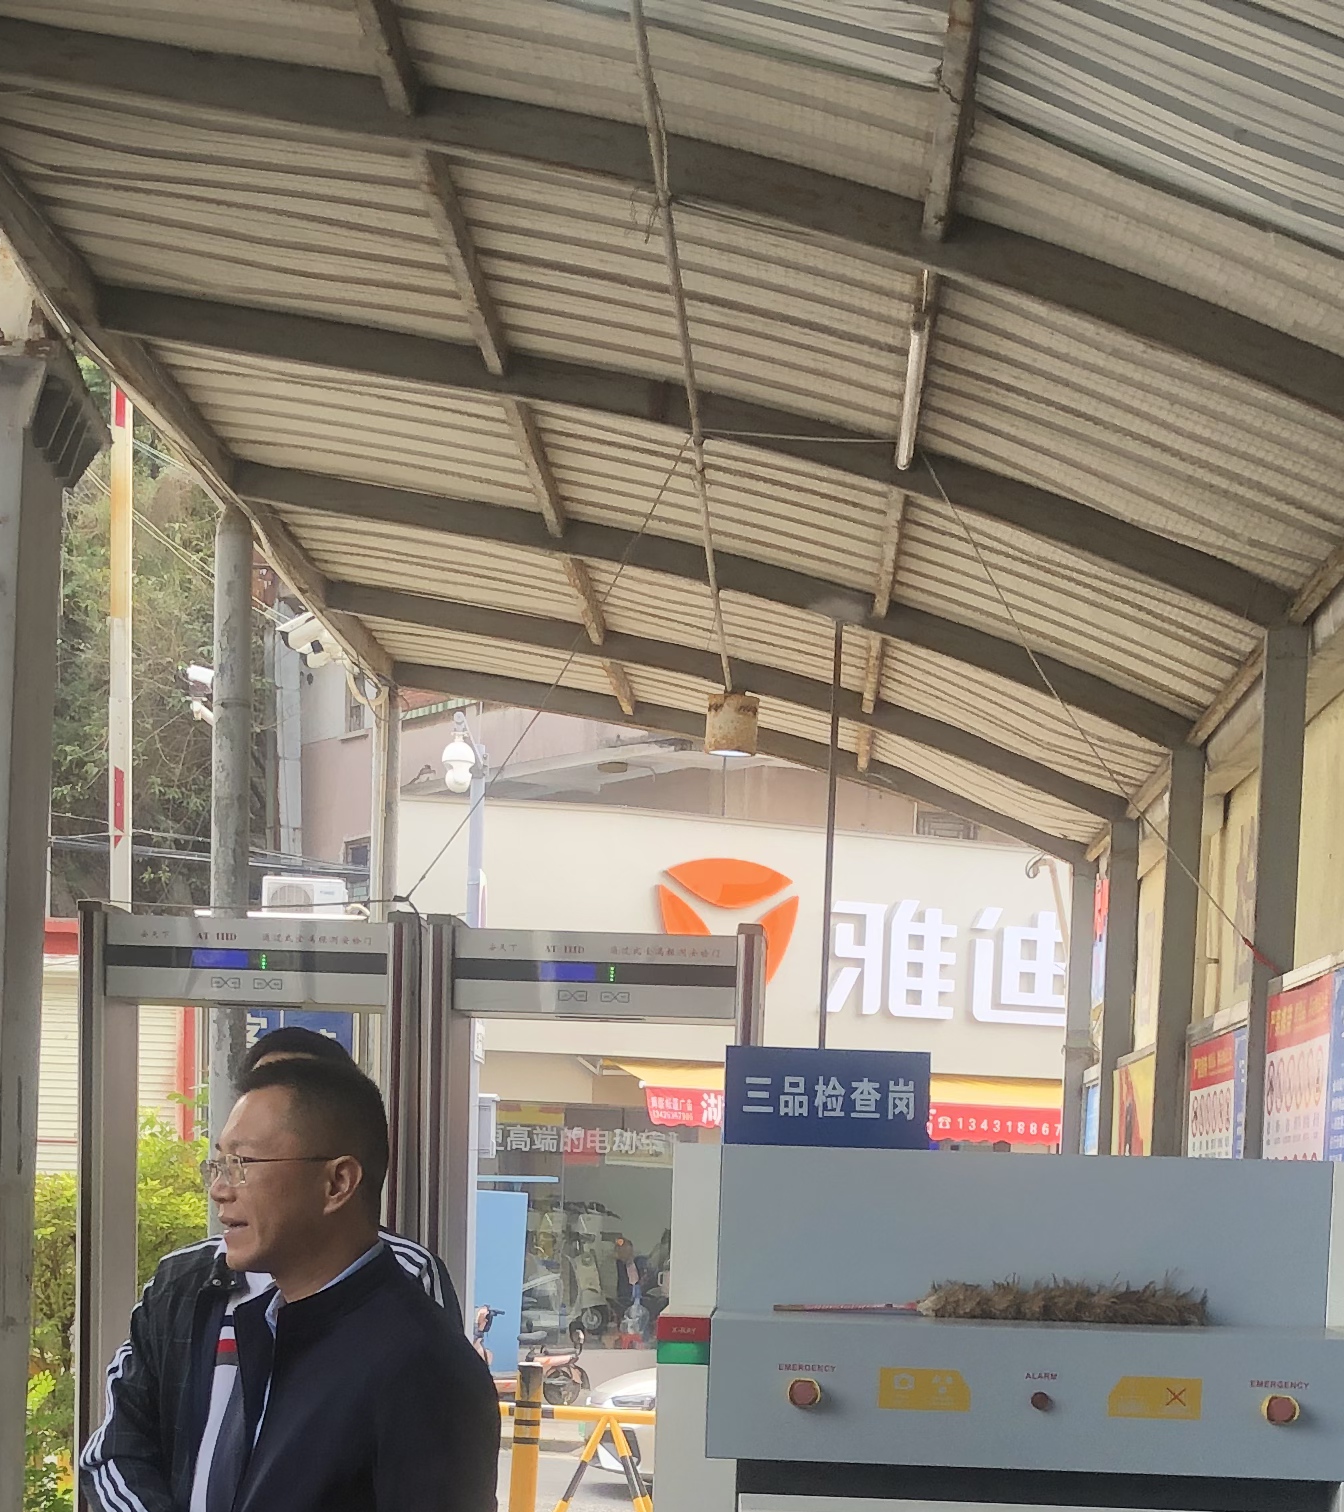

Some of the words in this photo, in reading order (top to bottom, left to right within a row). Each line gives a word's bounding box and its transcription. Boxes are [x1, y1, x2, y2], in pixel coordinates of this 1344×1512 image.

[827, 899, 1065, 1027] 雅迪
[742, 1075, 916, 1121] 三品检查岗
[671, 1326, 697, 1336] X-RAY
[777, 1363, 837, 1374] EMERGENCY
[1025, 1372, 1058, 1381] ALARM
[1249, 1380, 1310, 1391] EMERGENCY
